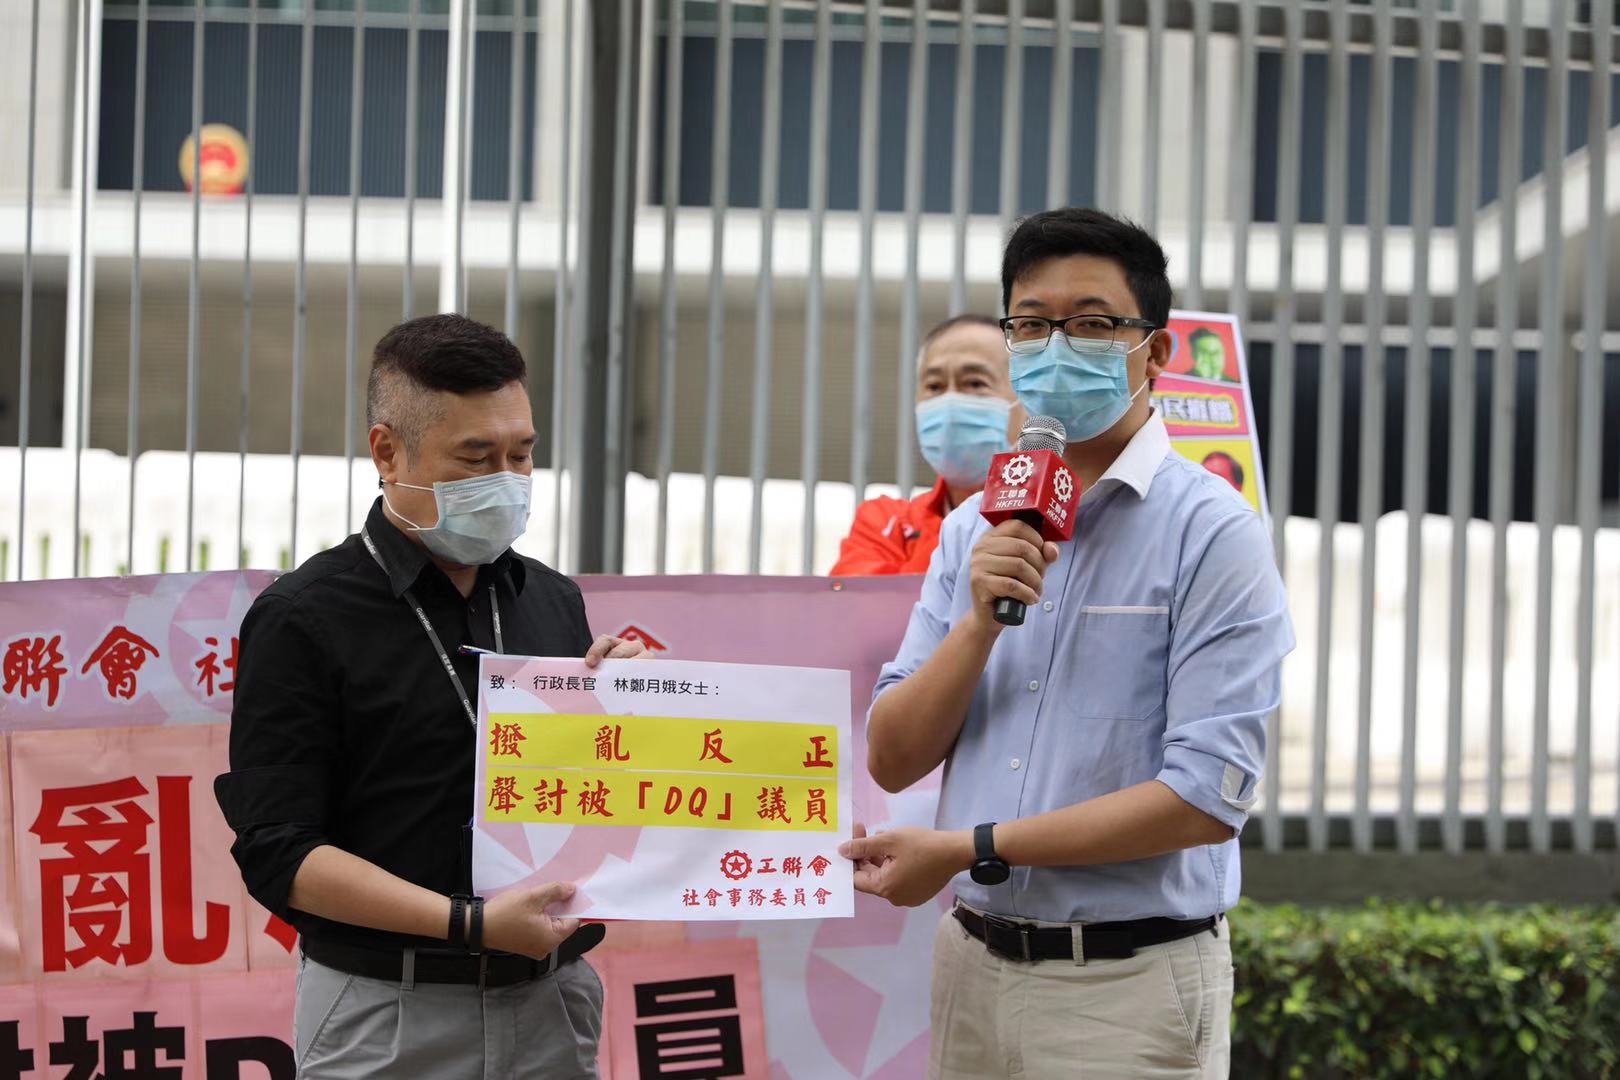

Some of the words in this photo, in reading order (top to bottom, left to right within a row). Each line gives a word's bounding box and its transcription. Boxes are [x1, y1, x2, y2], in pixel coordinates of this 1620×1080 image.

[995, 499, 1025, 508] HKFTU
[997, 488, 1028, 499] 工聯會
[1046, 508, 1065, 529] HKFTU
[416, 607, 432, 631] Guardian
[2, 625, 160, 706] 聯會
[533, 675, 597, 691] 行政長官
[463, 699, 478, 725] Guardian
[29, 775, 230, 973] 亂
[756, 855, 833, 879] 工聯會
[682, 887, 832, 907] 社會事務委員會
